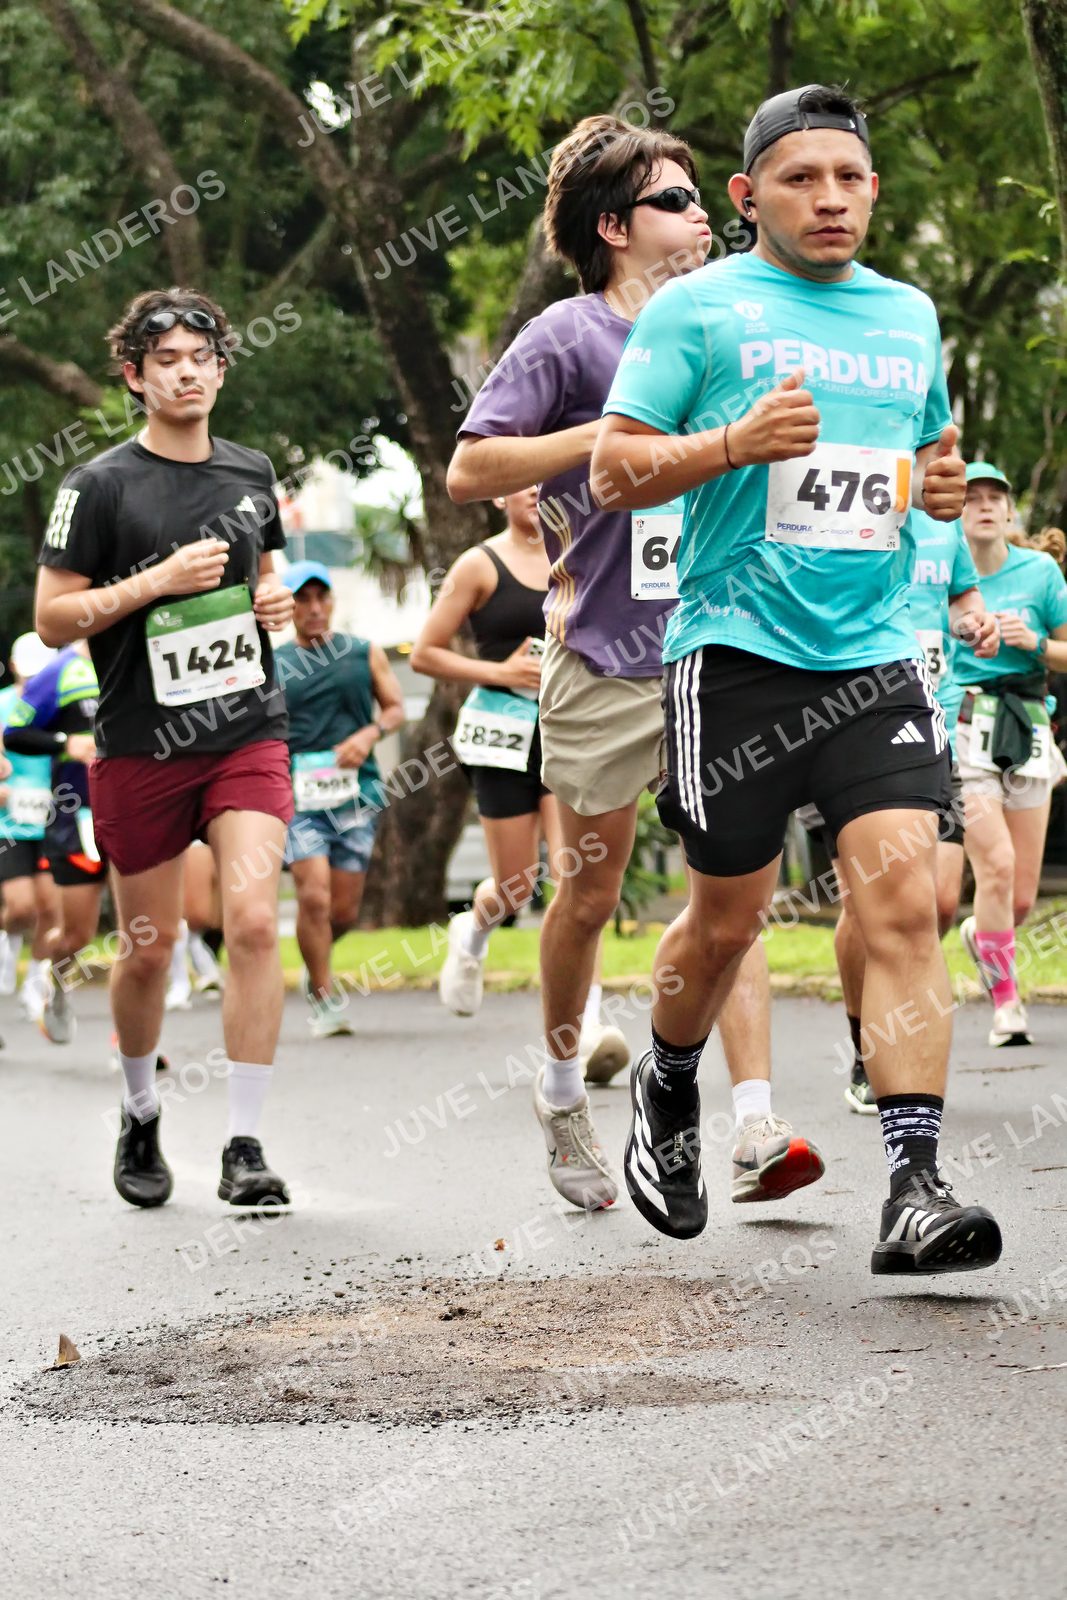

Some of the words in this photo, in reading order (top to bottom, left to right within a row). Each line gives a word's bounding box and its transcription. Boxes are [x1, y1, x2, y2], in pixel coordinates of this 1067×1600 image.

[740, 339, 927, 397] PERDURA
[797, 468, 891, 515] 476
[777, 522, 812, 532] PERDURA
[162, 634, 255, 681] 1424
